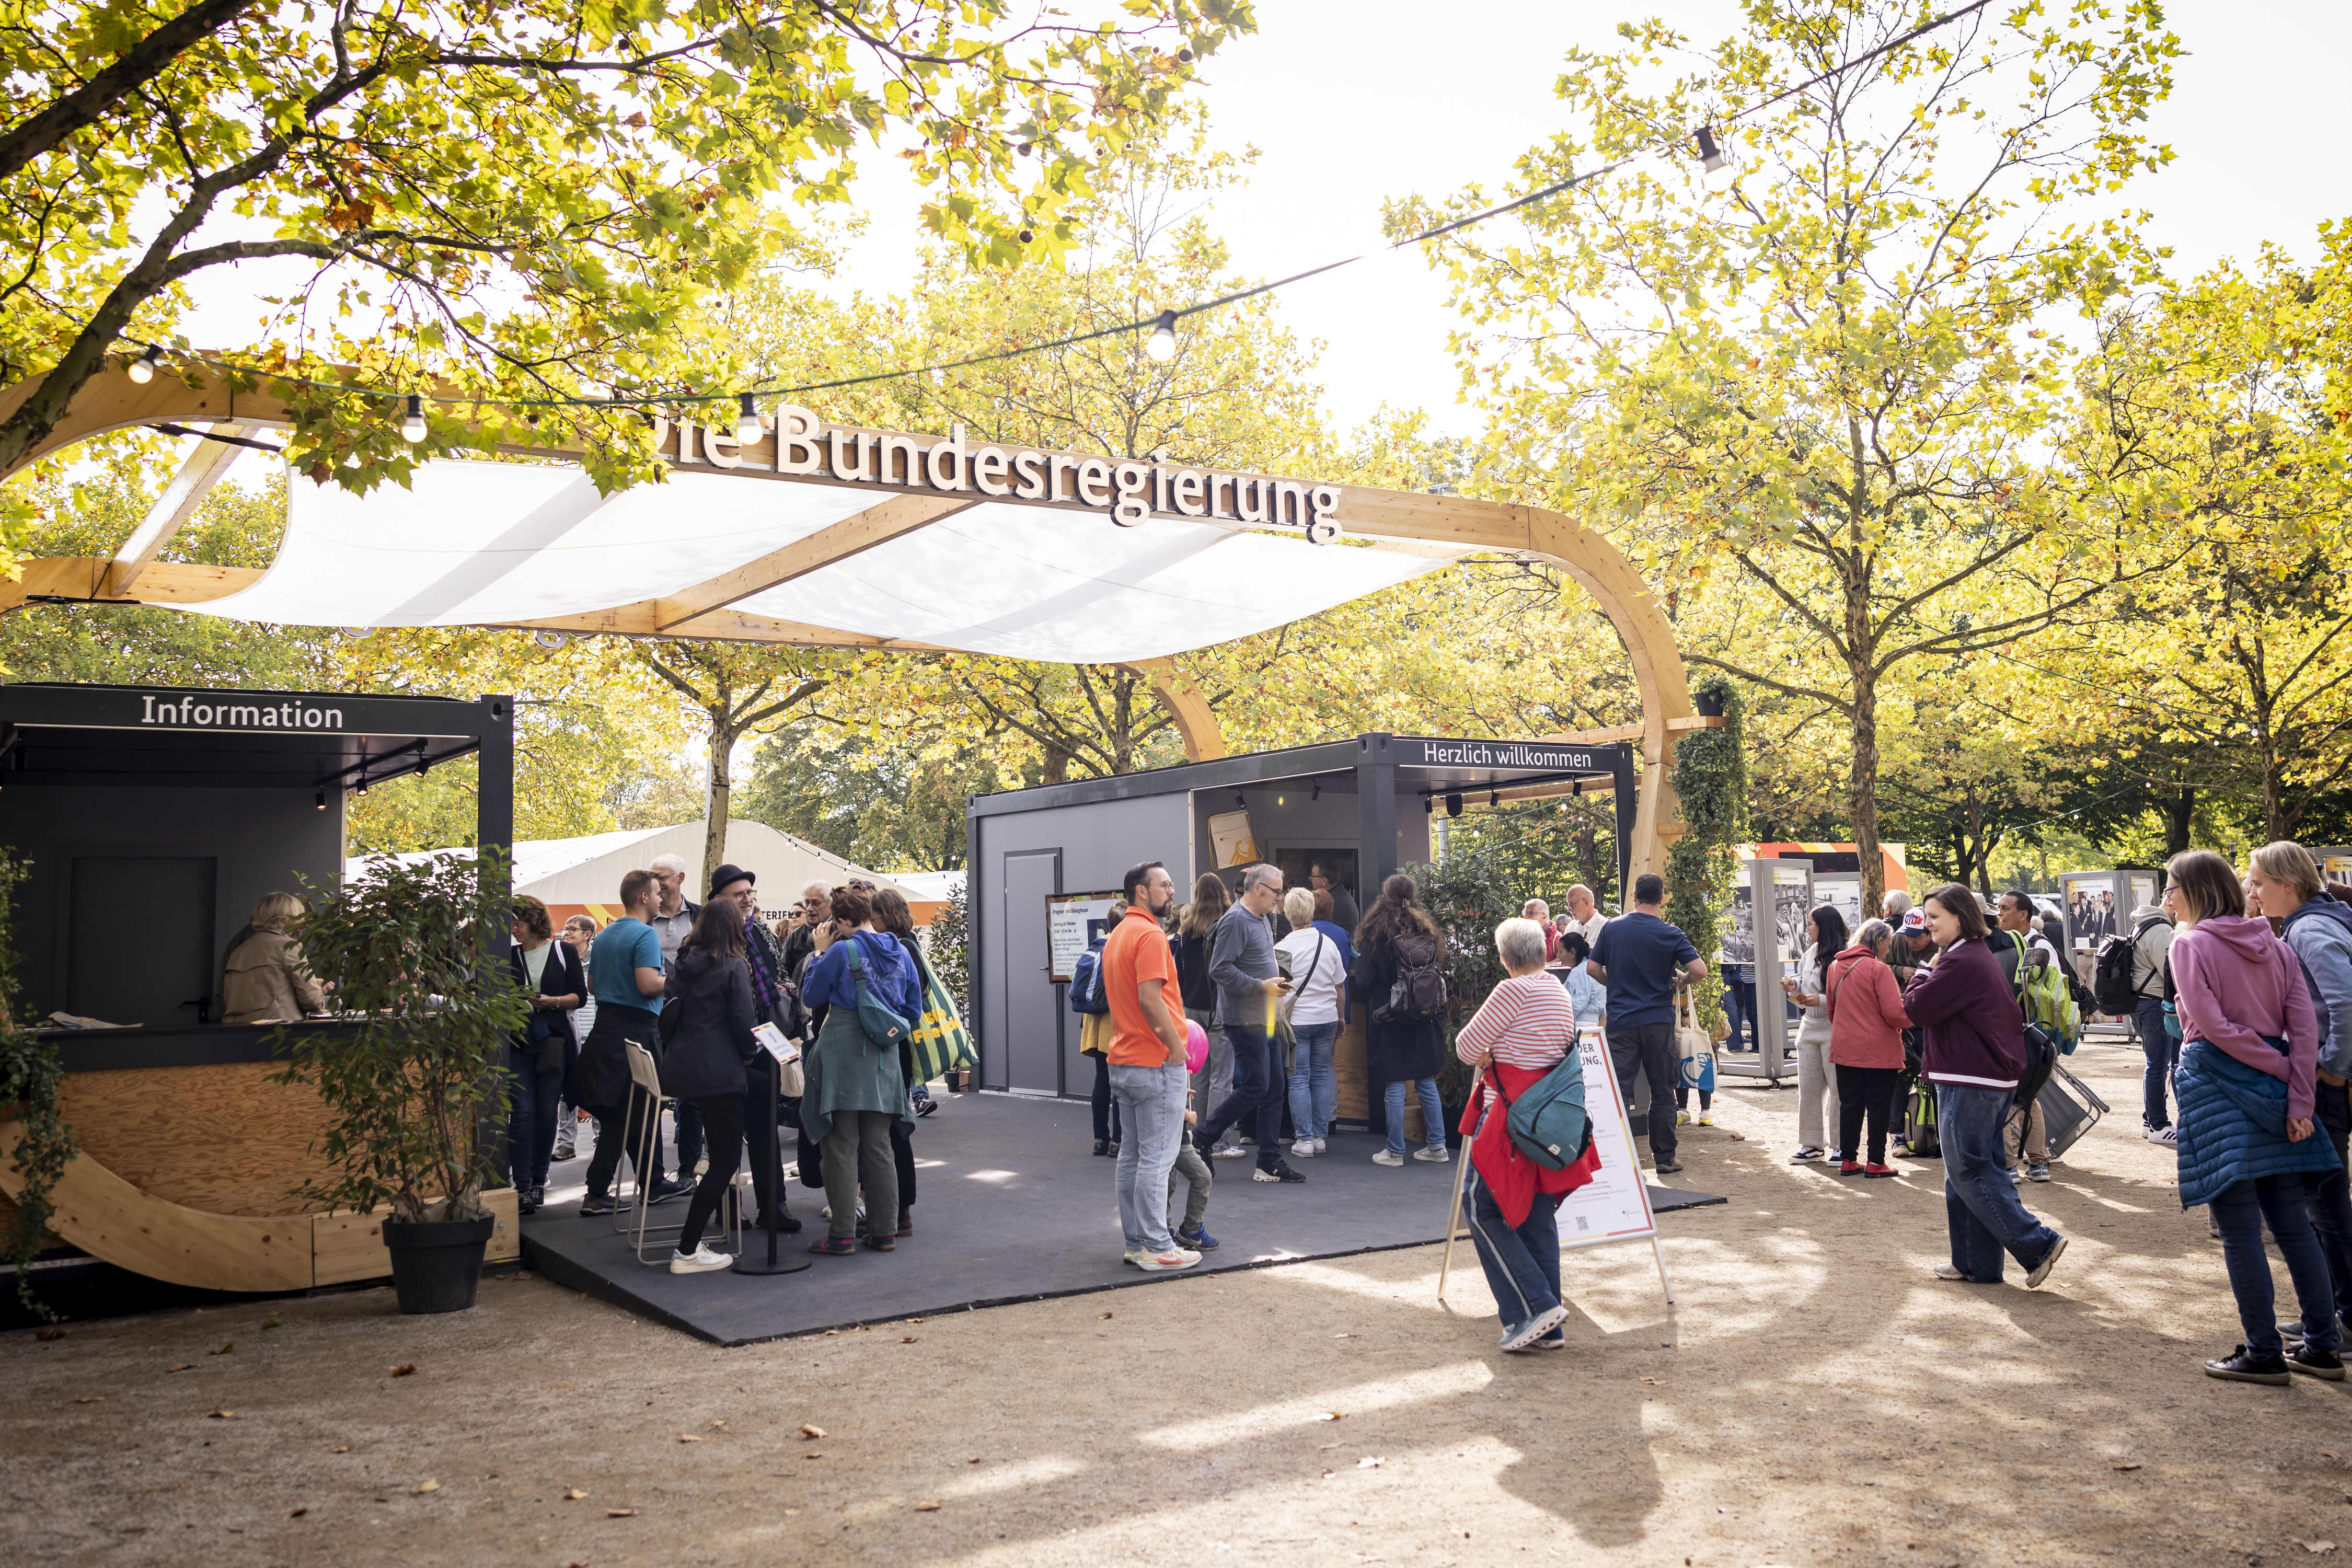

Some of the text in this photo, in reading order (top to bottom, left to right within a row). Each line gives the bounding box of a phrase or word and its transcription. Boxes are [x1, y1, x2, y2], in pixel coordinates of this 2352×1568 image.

[774, 403, 1343, 547] Bundesregierung
[142, 696, 343, 729] Information
[1424, 742, 1592, 768] Herzlich willkommen
[912, 1017, 961, 1044] Freude
[923, 1009, 947, 1025] Bio
